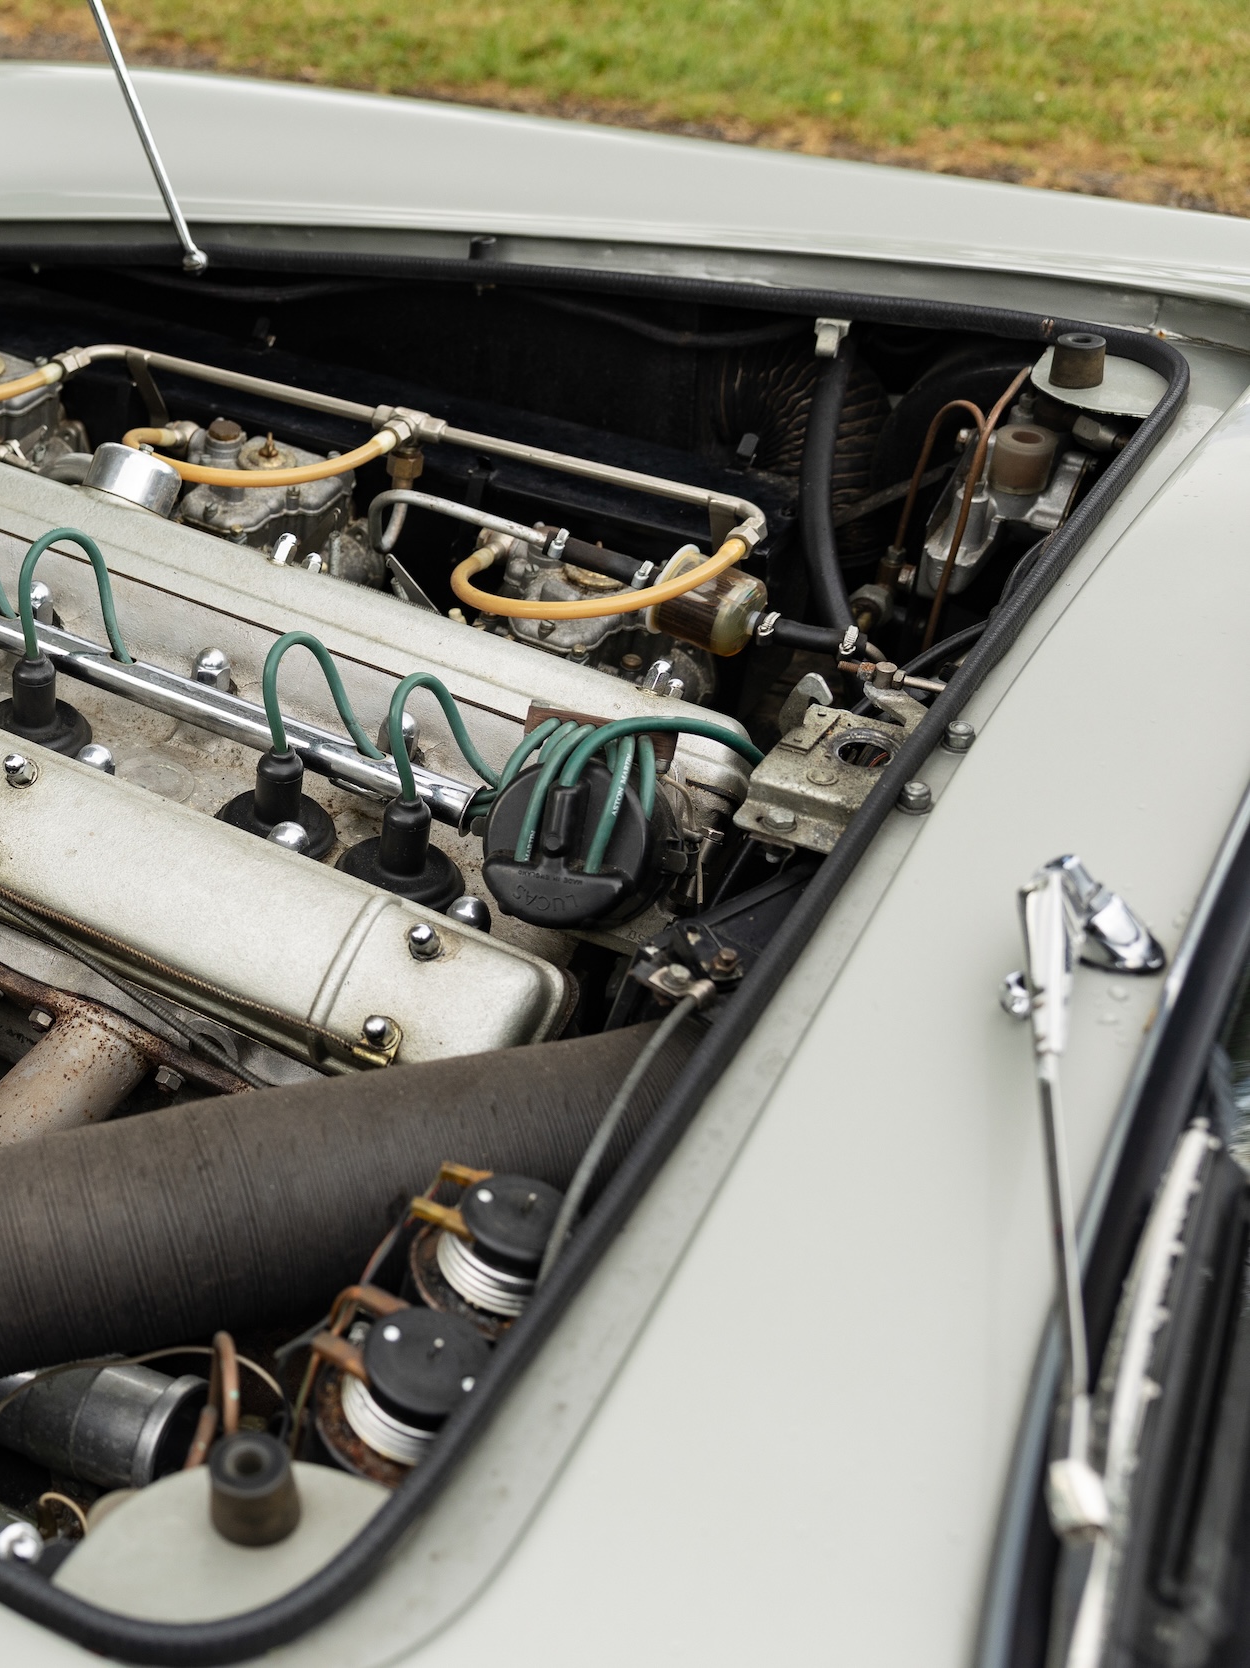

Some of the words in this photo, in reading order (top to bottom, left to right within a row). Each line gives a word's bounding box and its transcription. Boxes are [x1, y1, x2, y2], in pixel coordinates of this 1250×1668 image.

[611, 787, 625, 817] ASTON
[620, 753, 633, 785] MARTIN
[524, 830, 536, 861] MARTIN
[518, 870, 550, 881] ENGLAND
[563, 877, 583, 885] MADE
[512, 884, 579, 911] LUCAS
